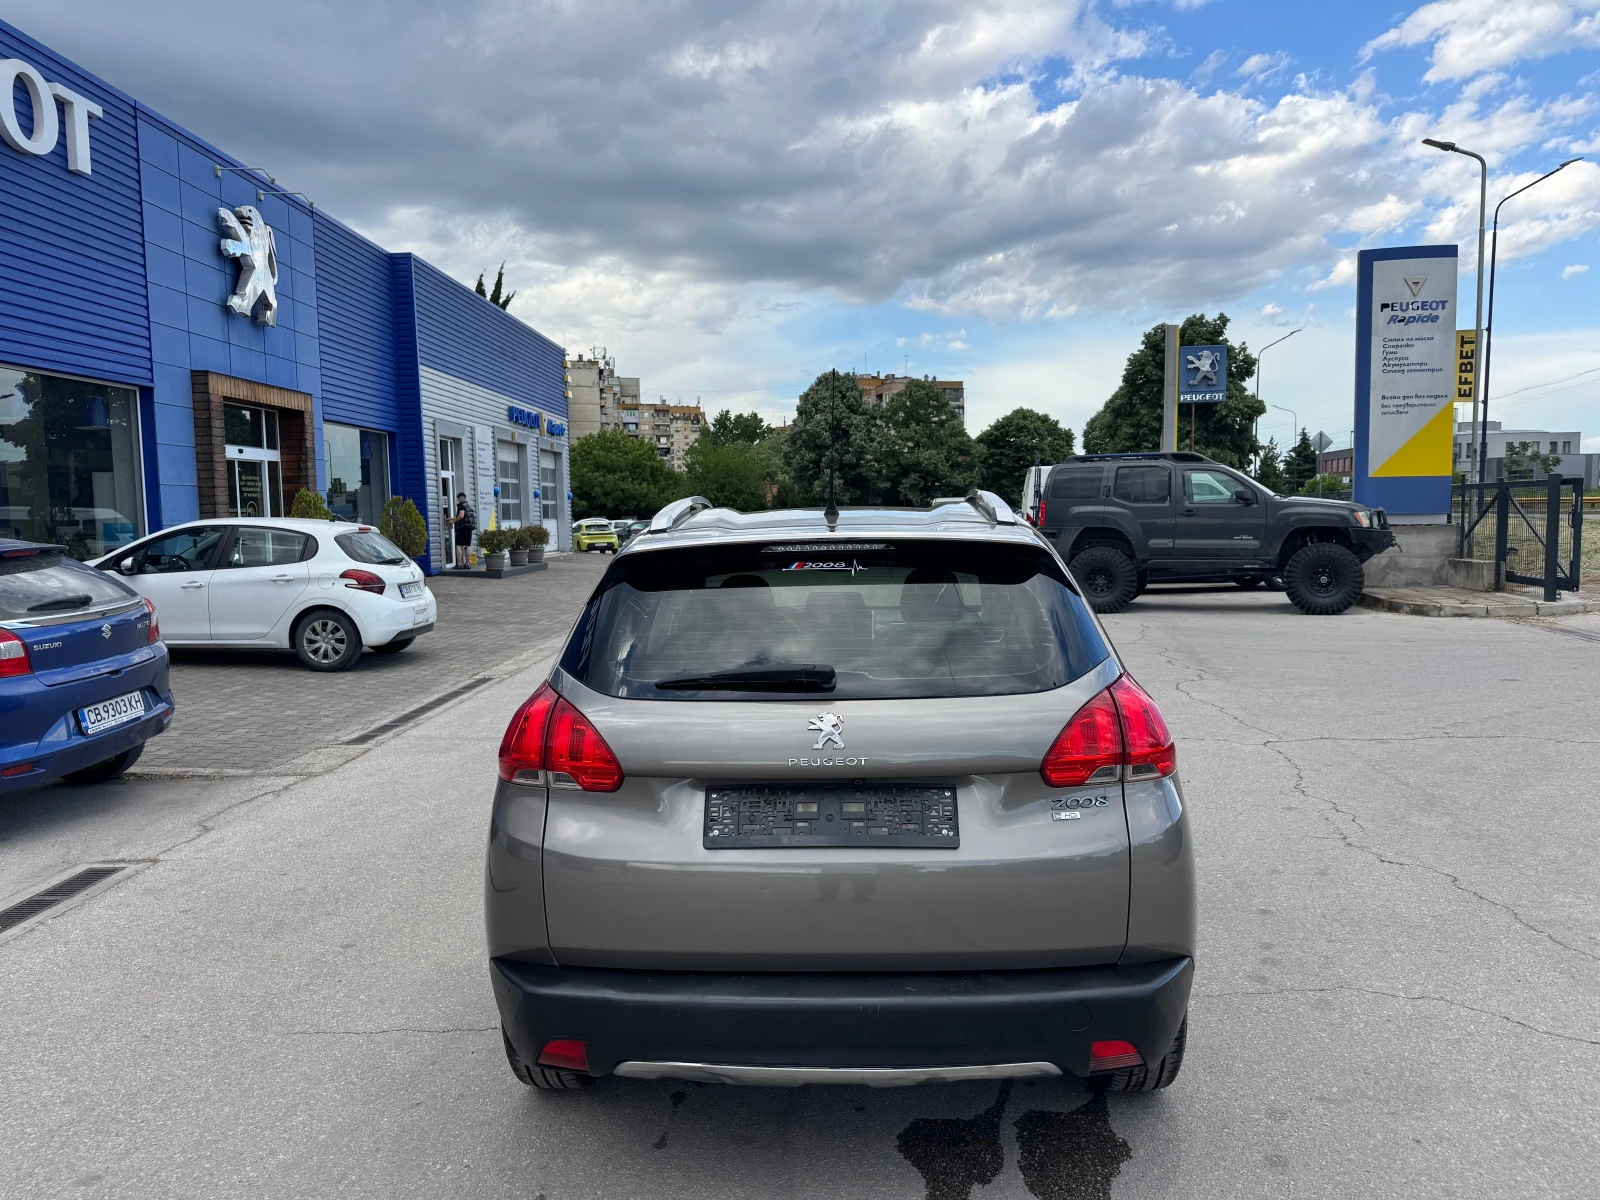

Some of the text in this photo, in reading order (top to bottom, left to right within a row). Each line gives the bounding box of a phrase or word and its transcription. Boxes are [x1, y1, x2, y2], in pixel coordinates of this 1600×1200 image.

[1380, 300, 1448, 312] PEUGEOT
[1387, 313, 1440, 326] Rapide
[1458, 335, 1475, 397] EFBET
[1180, 393, 1225, 401] PEUGEOT
[33, 641, 62, 651] SUZUKI
[788, 757, 868, 766] PEUGEOT
[1051, 795, 1109, 810] 2008
